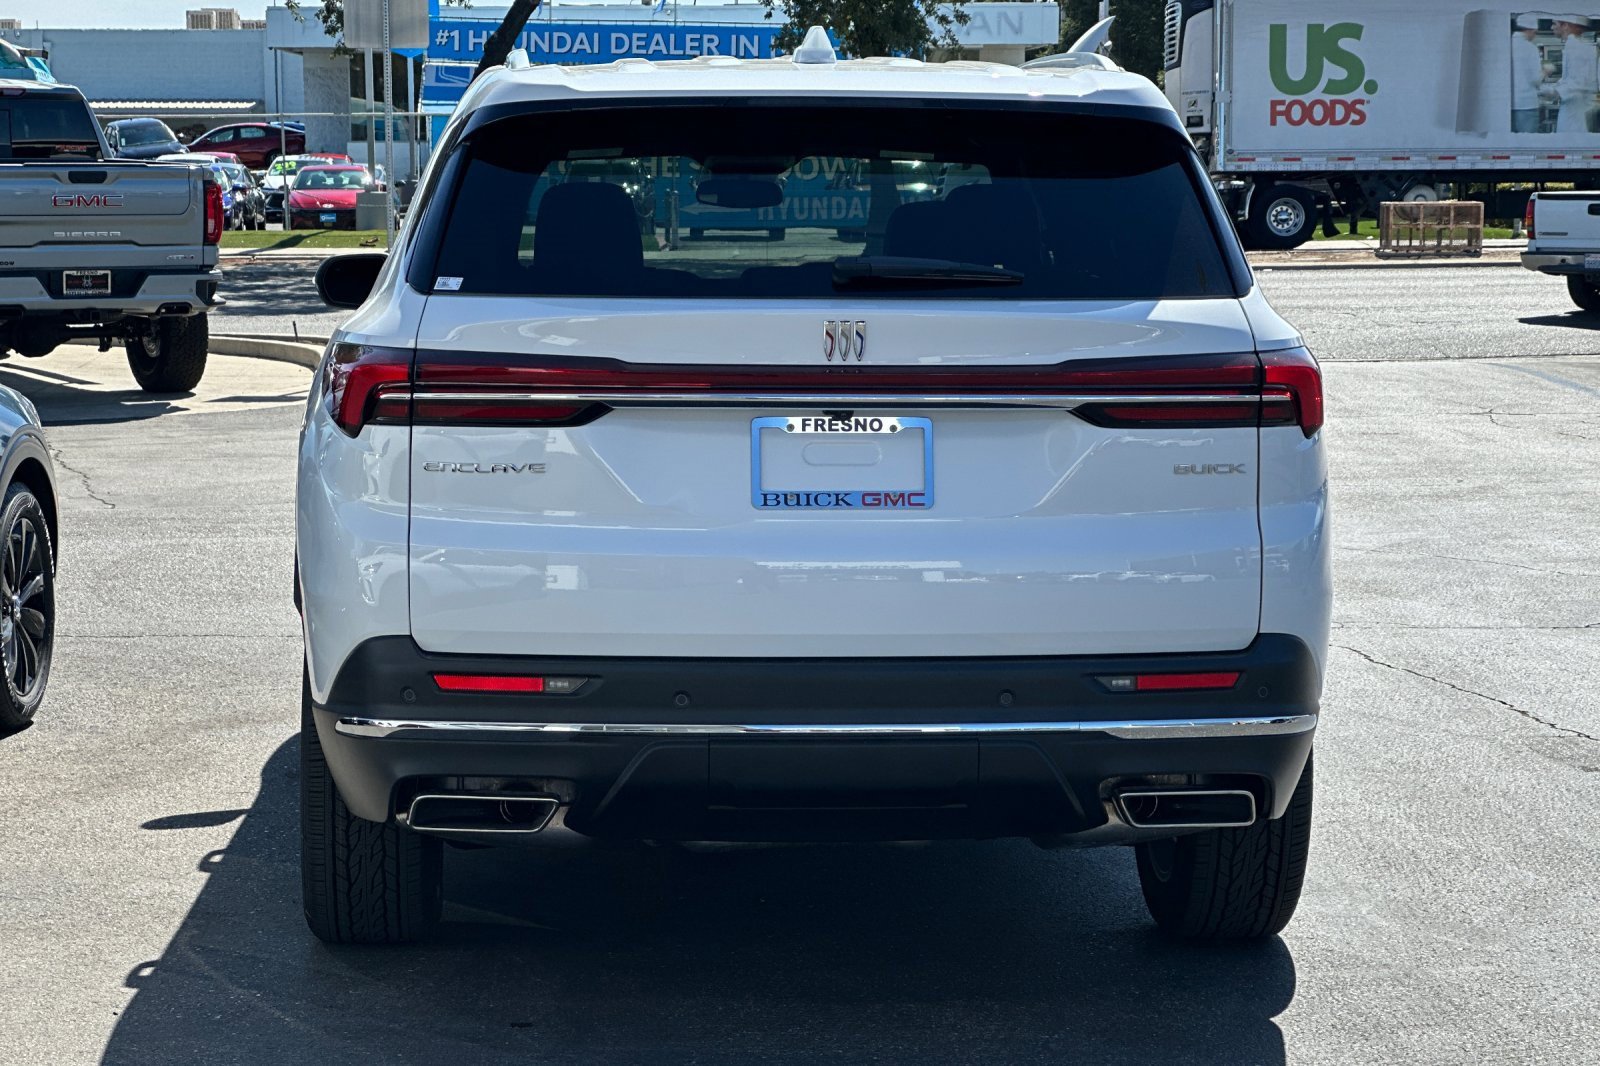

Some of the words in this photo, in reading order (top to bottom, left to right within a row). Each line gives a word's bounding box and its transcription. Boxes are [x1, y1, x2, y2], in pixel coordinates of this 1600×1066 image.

[435, 29, 461, 52] #1
[468, 29, 599, 54] HUNDAI
[610, 32, 720, 57] DEALER
[731, 34, 759, 57] IN
[1269, 98, 1367, 126] FOODS
[52, 194, 124, 208] GMC
[801, 418, 883, 433] FRESNO
[422, 461, 546, 474] ENCLAVE
[1173, 463, 1248, 475] BUICK
[760, 492, 854, 508] BUICK
[861, 492, 926, 507] GMC
